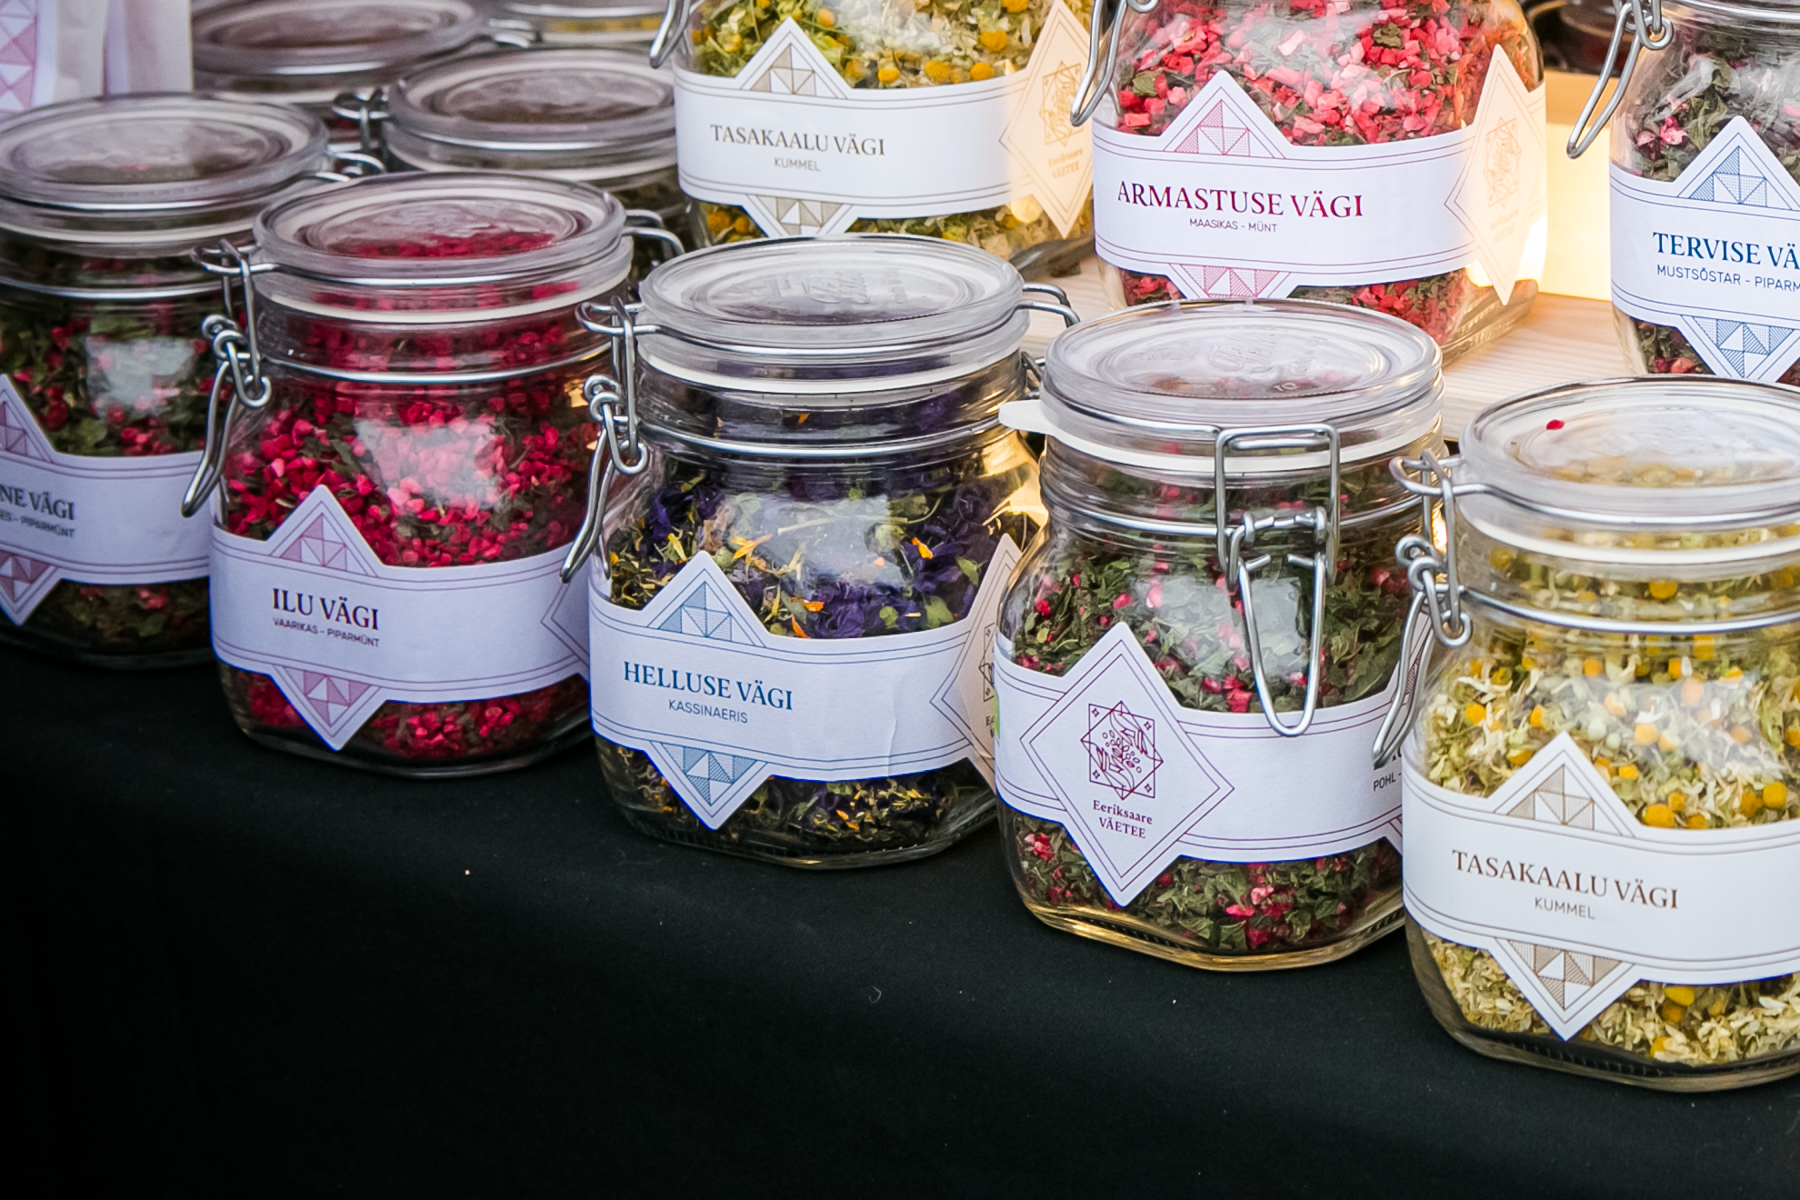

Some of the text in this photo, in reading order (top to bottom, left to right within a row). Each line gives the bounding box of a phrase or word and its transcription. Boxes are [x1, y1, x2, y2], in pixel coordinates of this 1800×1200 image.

[710, 124, 885, 156] TASAKAALU VÄGI
[773, 156, 821, 172] KUMMEL
[1117, 180, 1363, 218] ARMASTUSE VÄGI
[1189, 218, 1237, 231] MAASIKAS
[1248, 220, 1277, 234] MÜNT
[1653, 232, 1761, 265] TERVISE
[1656, 263, 1741, 287] MUSTSÕSTAR
[28, 490, 75, 521] VÄGI
[272, 588, 378, 631] ILU VÄGI
[272, 617, 318, 634] VAARIKAS
[327, 626, 379, 647] PIPARMÜNT
[623, 663, 793, 711] HELLUSE VÄGI
[668, 698, 748, 723] KASSINAERIS
[1373, 772, 1397, 792] POHL
[1092, 799, 1153, 825] Eeriksaare
[1098, 816, 1146, 839] VÄETEE
[1452, 849, 1679, 910] TASAKAALU VÄGI
[1534, 897, 1596, 919] KUMMEL
